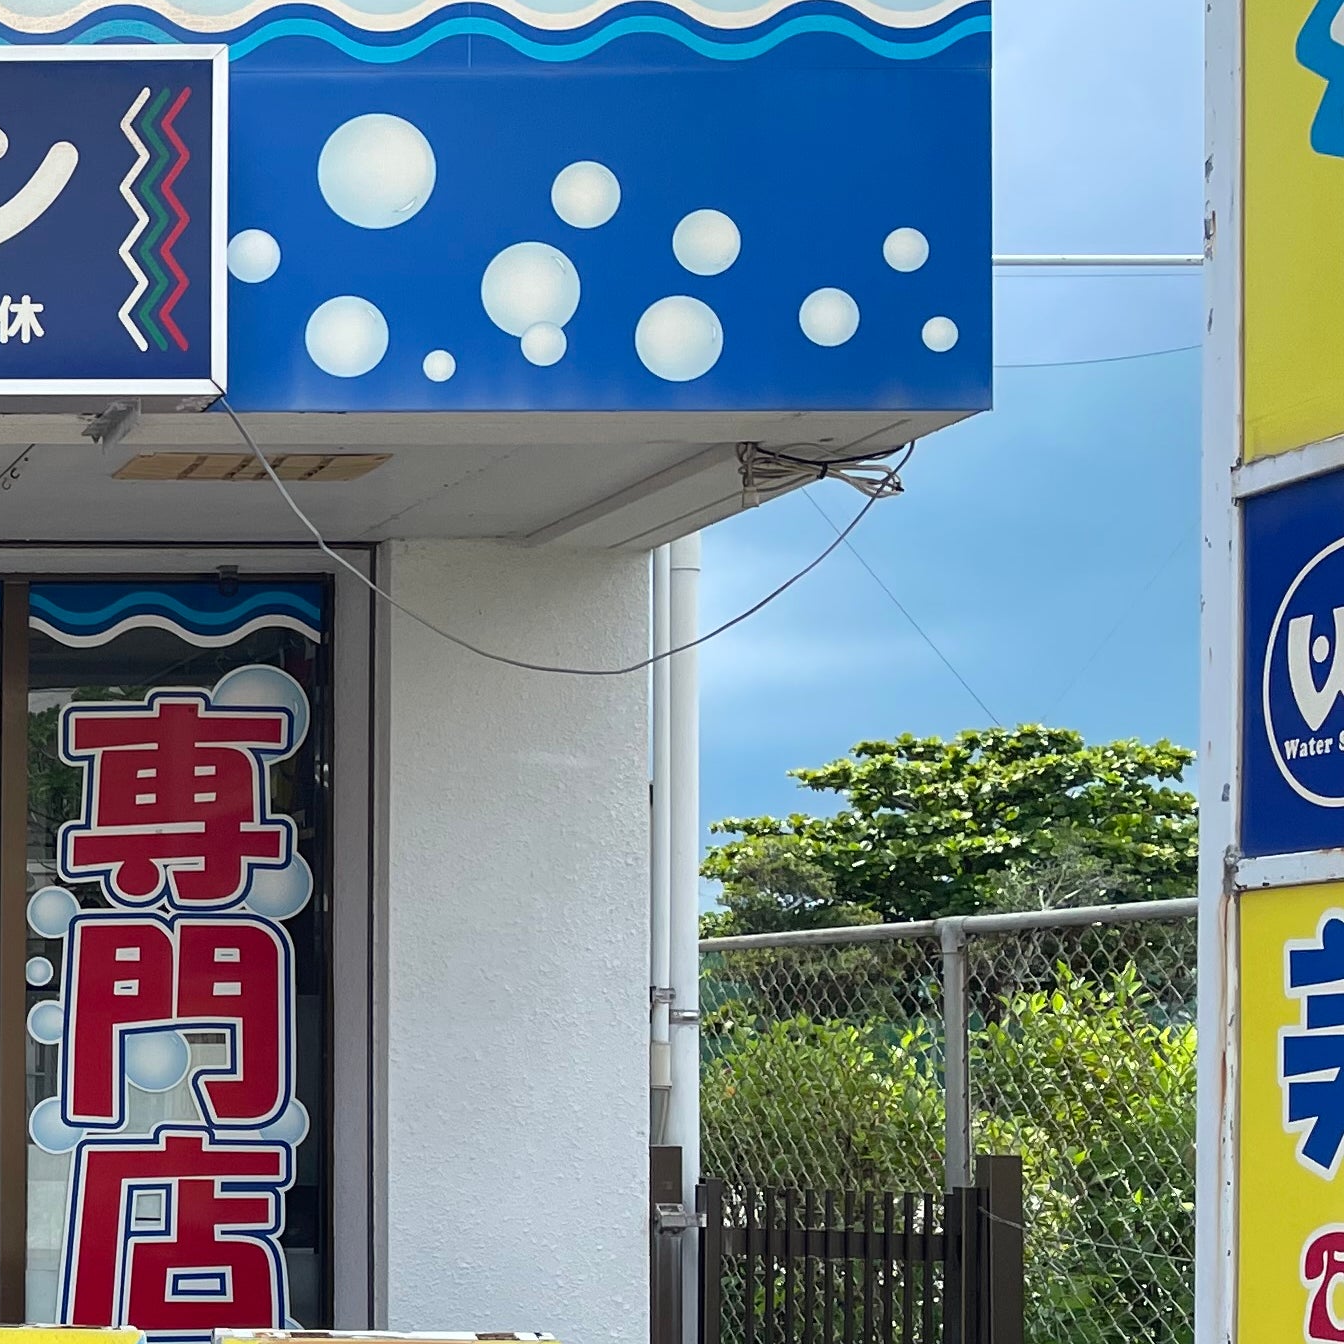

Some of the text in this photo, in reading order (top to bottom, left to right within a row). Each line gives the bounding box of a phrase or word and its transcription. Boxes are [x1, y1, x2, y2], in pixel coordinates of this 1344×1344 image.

[1284, 738, 1333, 760] Water
[60, 691, 295, 1330] 専門店
